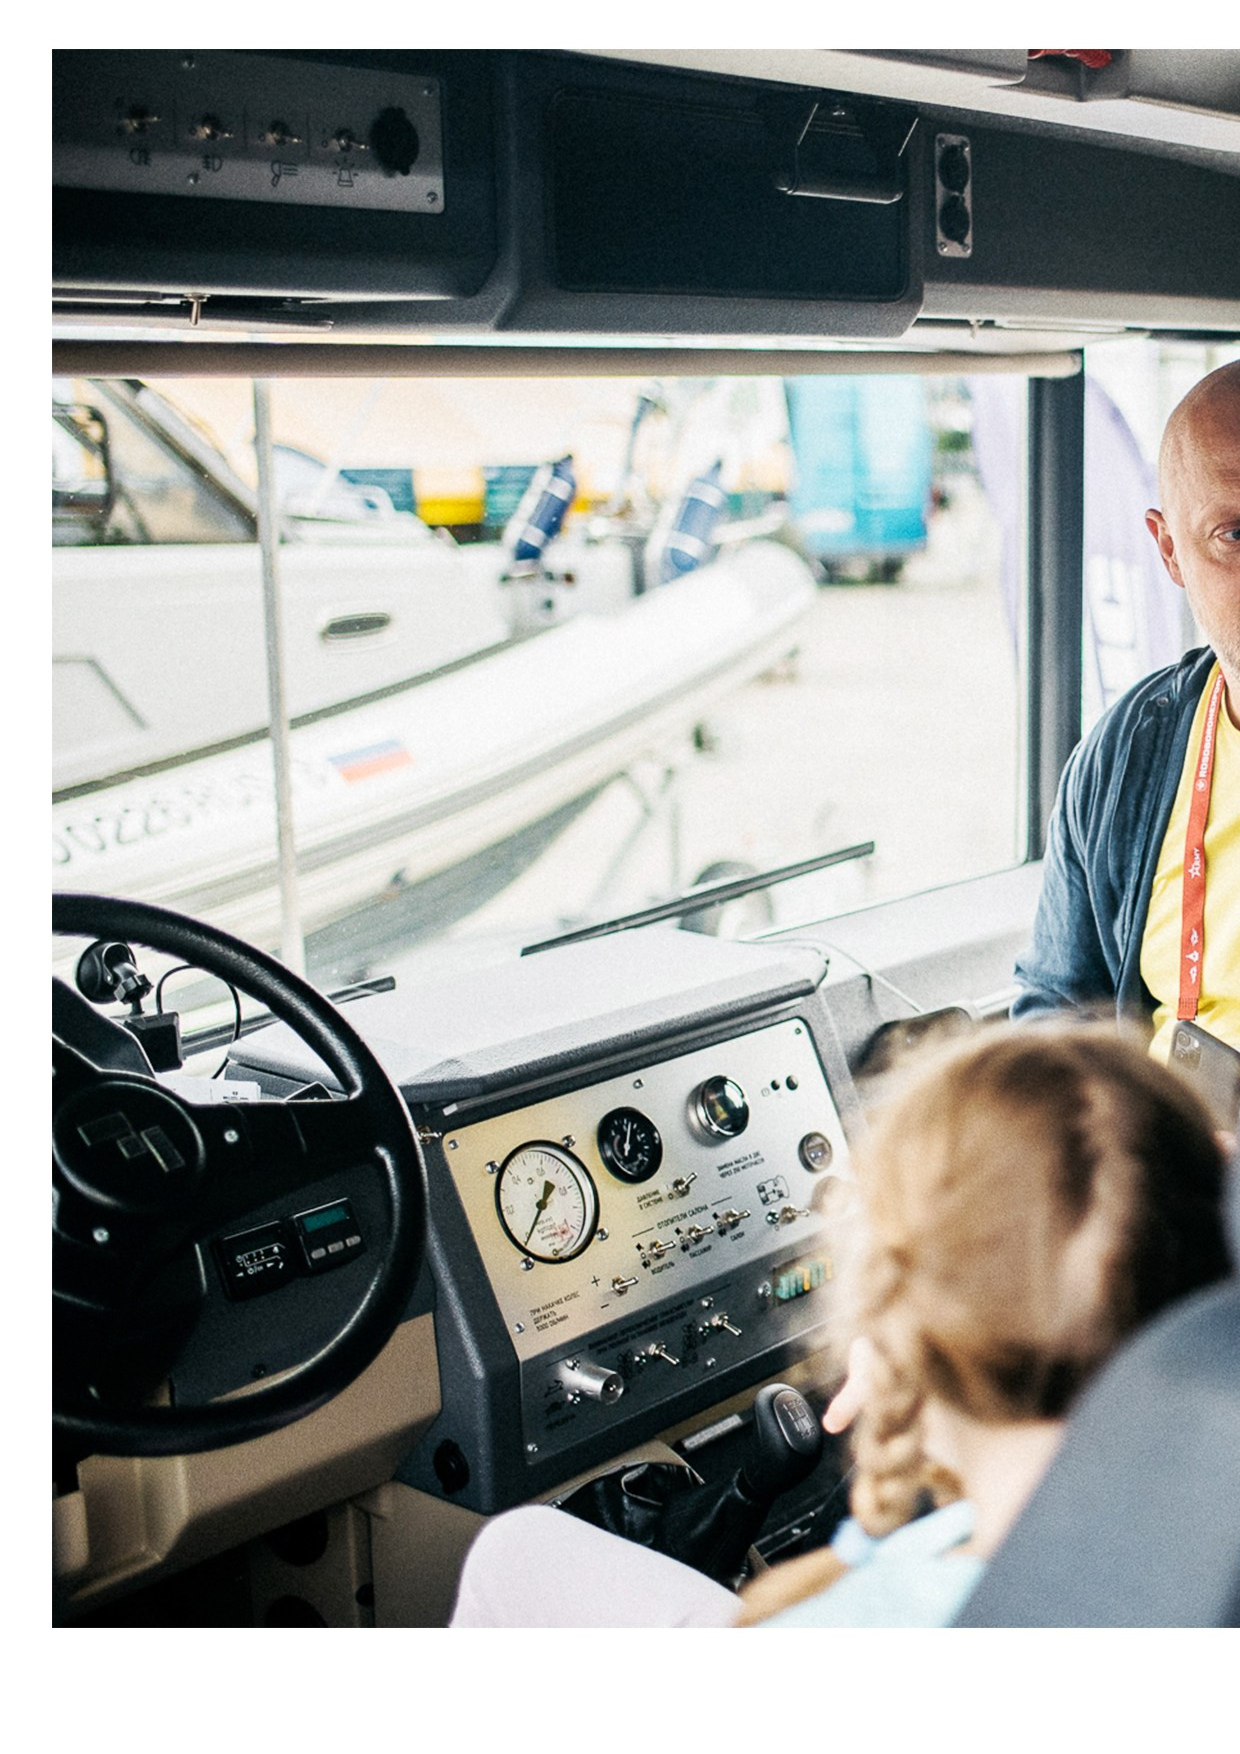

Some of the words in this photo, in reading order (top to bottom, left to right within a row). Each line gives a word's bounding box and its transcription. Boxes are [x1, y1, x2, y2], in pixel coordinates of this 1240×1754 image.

[637, 1189, 660, 1203] ДАВЛЕНИЕ
[656, 1211, 688, 1229] ОТОПИТЕЛИ
[688, 1204, 709, 1218] САЛОНА
[730, 1231, 745, 1242] САЛОН
